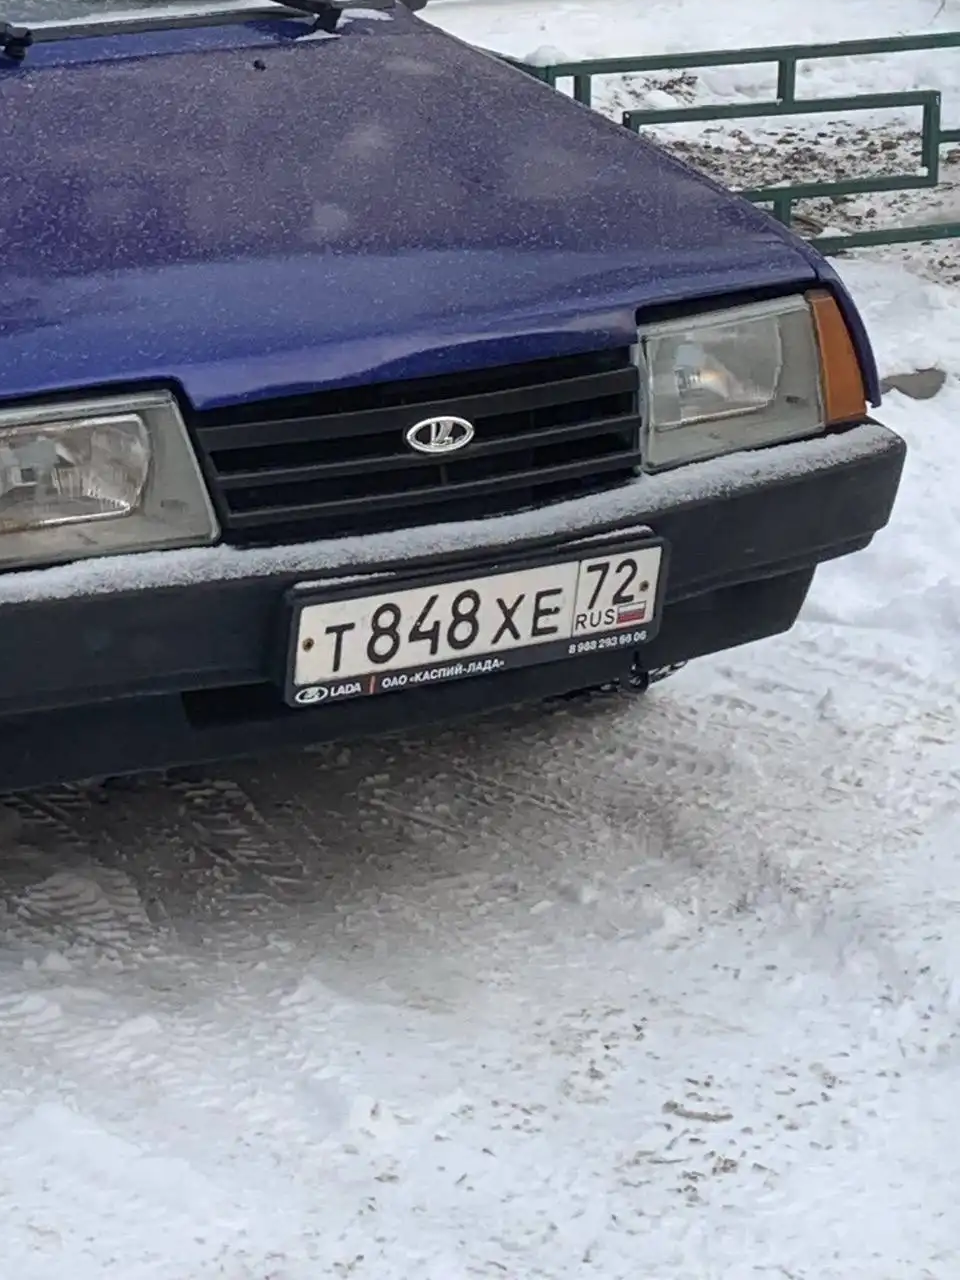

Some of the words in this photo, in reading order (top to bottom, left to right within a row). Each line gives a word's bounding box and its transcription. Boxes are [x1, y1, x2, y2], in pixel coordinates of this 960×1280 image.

[586, 558, 639, 610] 72
[574, 608, 616, 631] RUS
[330, 681, 362, 697] LADA
[381, 674, 407, 689] ОАО
